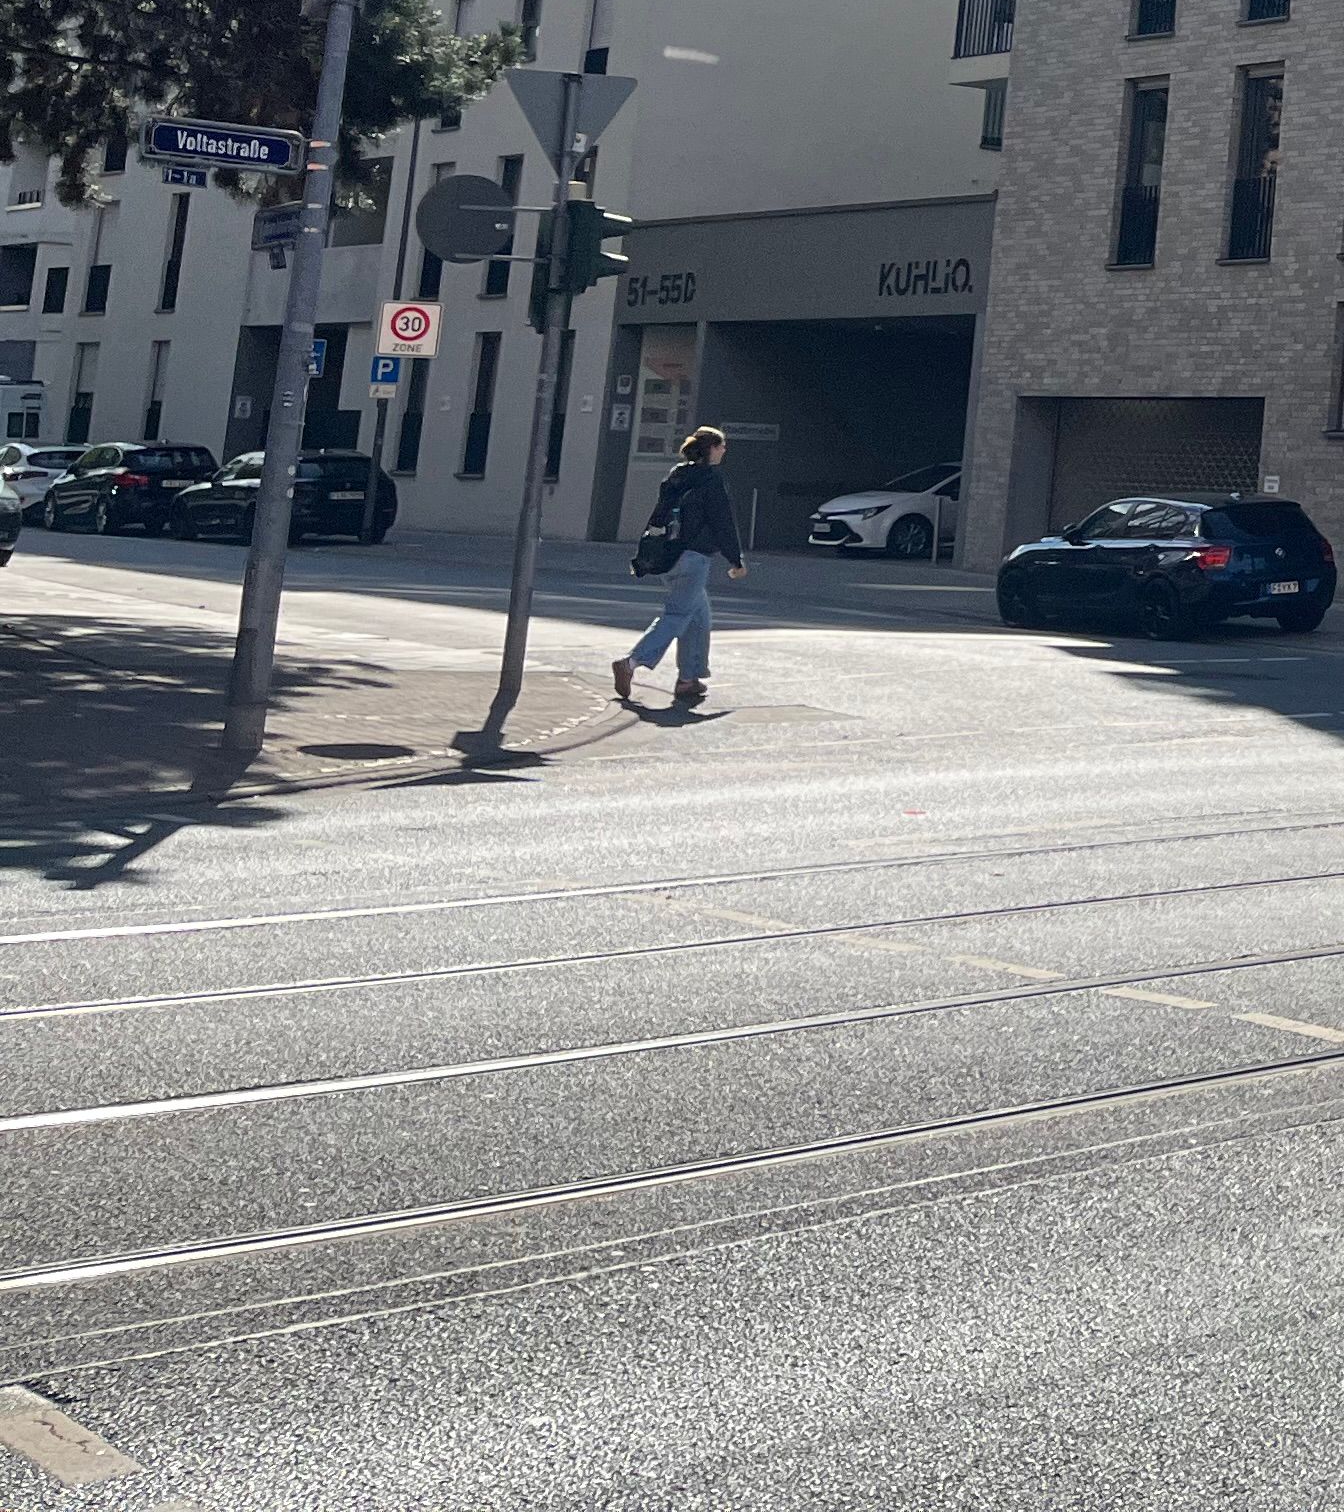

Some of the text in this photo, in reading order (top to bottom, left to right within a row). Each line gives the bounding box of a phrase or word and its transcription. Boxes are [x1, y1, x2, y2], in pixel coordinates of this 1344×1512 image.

[177, 130, 269, 160] Voltastraße
[399, 316, 422, 333] 30
[391, 342, 424, 353] ZONE
[377, 359, 394, 380] P
